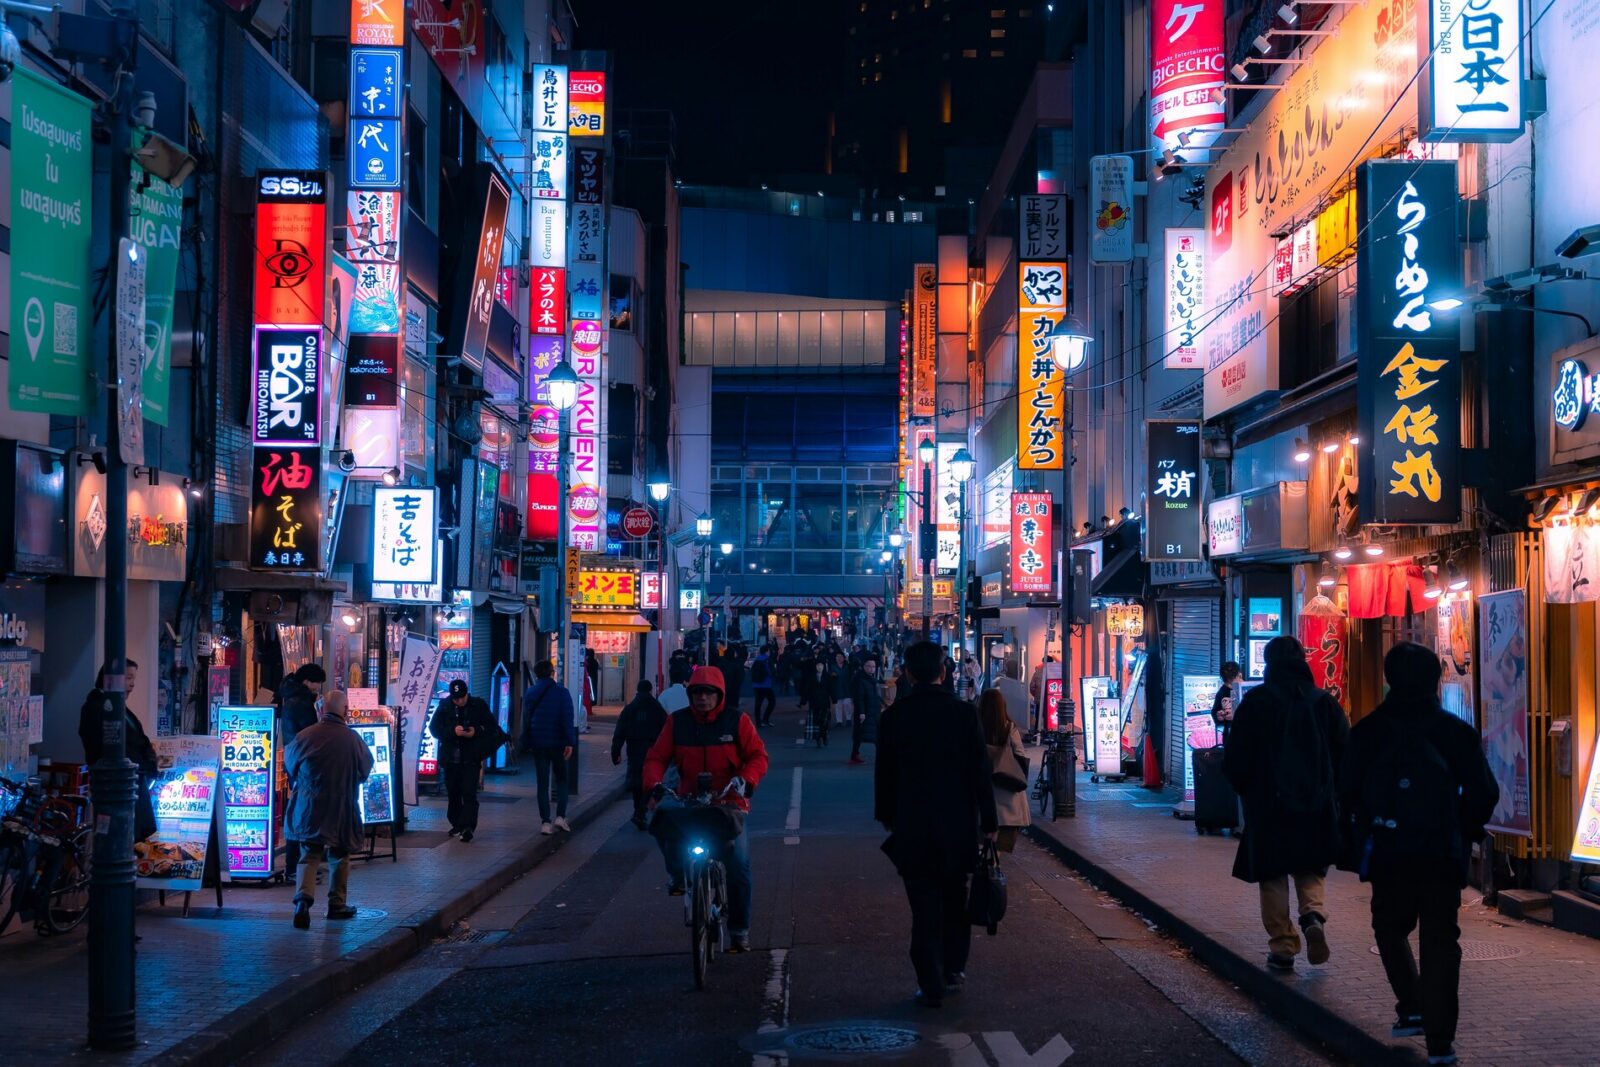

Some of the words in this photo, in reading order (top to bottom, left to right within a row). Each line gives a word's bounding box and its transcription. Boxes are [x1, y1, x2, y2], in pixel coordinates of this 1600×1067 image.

[358, 29, 394, 37] ROYAL
[1454, 0, 1509, 114] 日本一
[1152, 63, 1175, 89] BIG
[1178, 54, 1225, 73] ECHO
[261, 176, 323, 195] SSビル
[541, 205, 557, 215] Bar
[1393, 180, 1432, 332] らーめん
[538, 271, 557, 325] バラの木
[304, 336, 317, 380] ONIGIRI
[270, 345, 304, 429] BAR
[257, 370, 268, 438] HIROMATSU
[577, 358, 594, 472] RAKUEN
[1380, 341, 1450, 503] 金伝丸
[304, 423, 315, 438] 2F
[1016, 502, 1048, 516] 焼肉
[1165, 501, 1188, 509] kozue
[264, 551, 305, 566] 春日亭
[1166, 544, 1183, 554] B1
[222, 731, 237, 744] 2F
[242, 855, 264, 864] BAR
